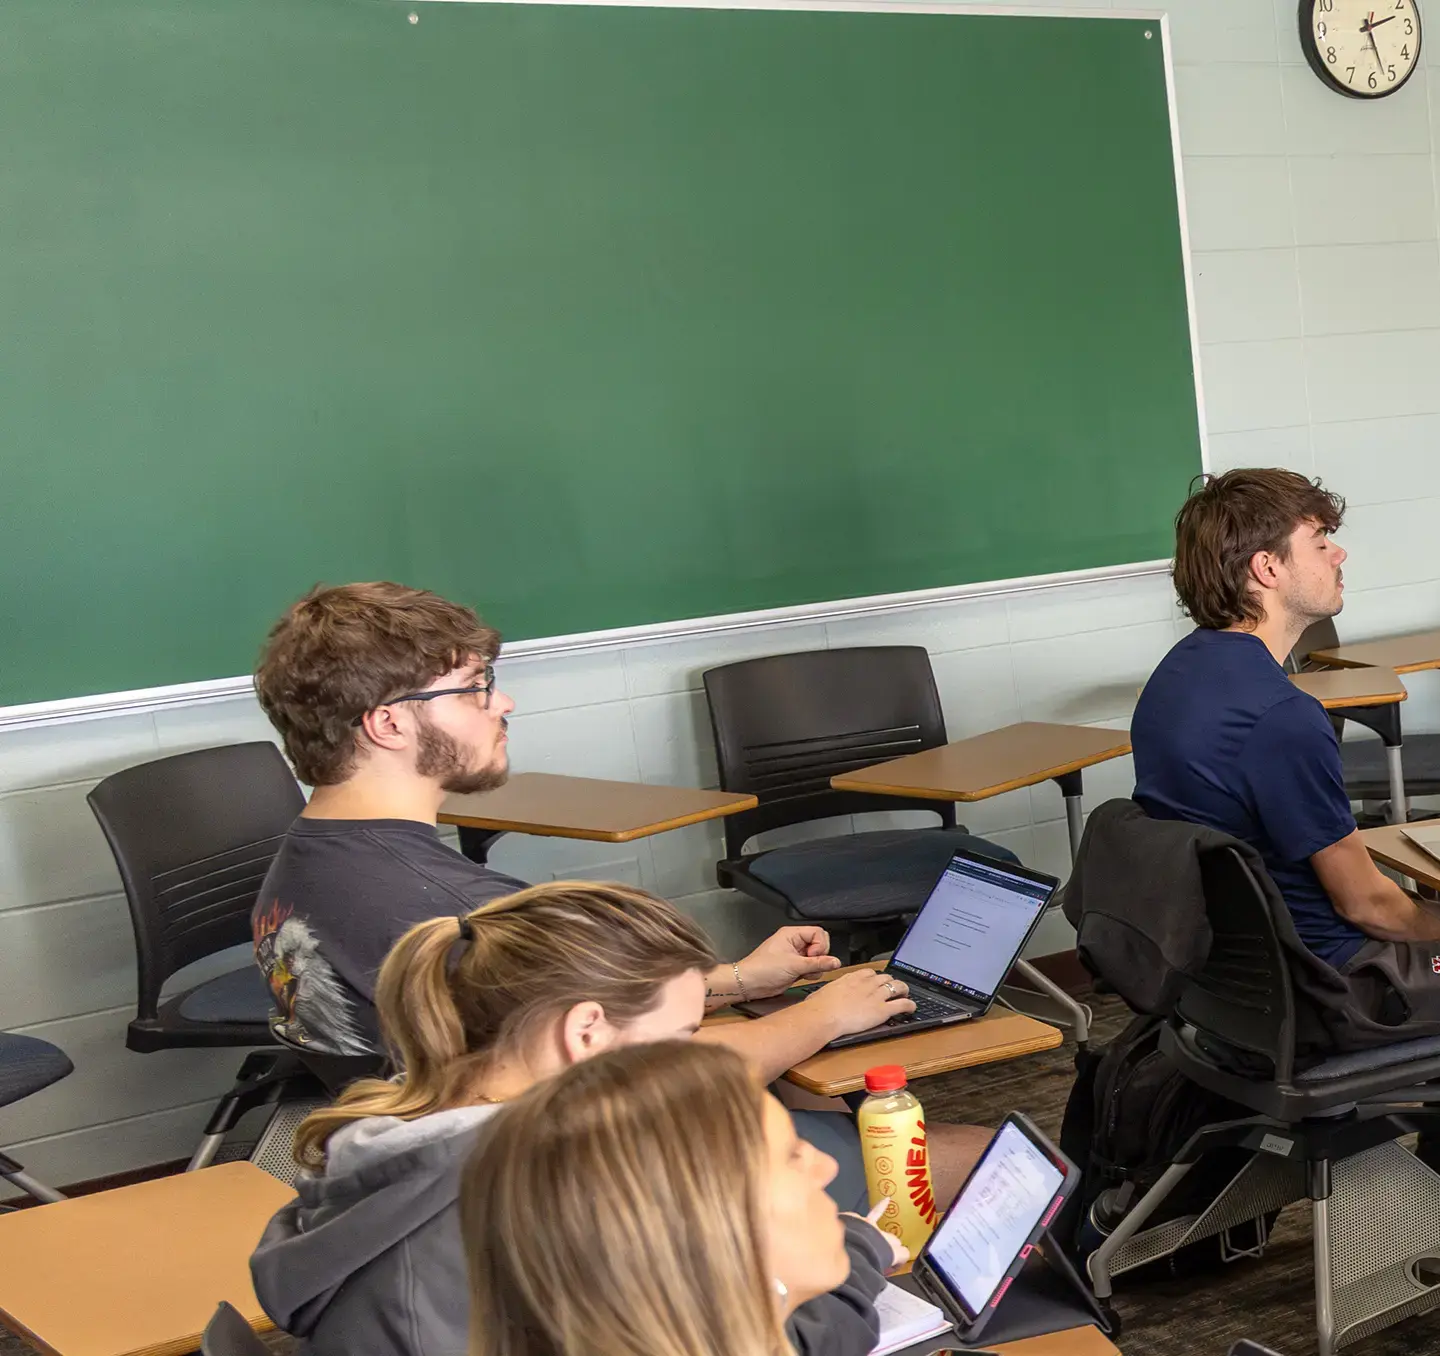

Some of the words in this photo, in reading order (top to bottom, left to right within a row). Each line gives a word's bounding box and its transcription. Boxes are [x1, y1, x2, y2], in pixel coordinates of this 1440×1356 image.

[1404, 18, 1413, 35] 3
[1327, 46, 1337, 64] 8
[1400, 43, 1410, 60] 4
[1346, 67, 1355, 84] 7
[1368, 71, 1377, 89] 6
[1387, 65, 1396, 82] 5
